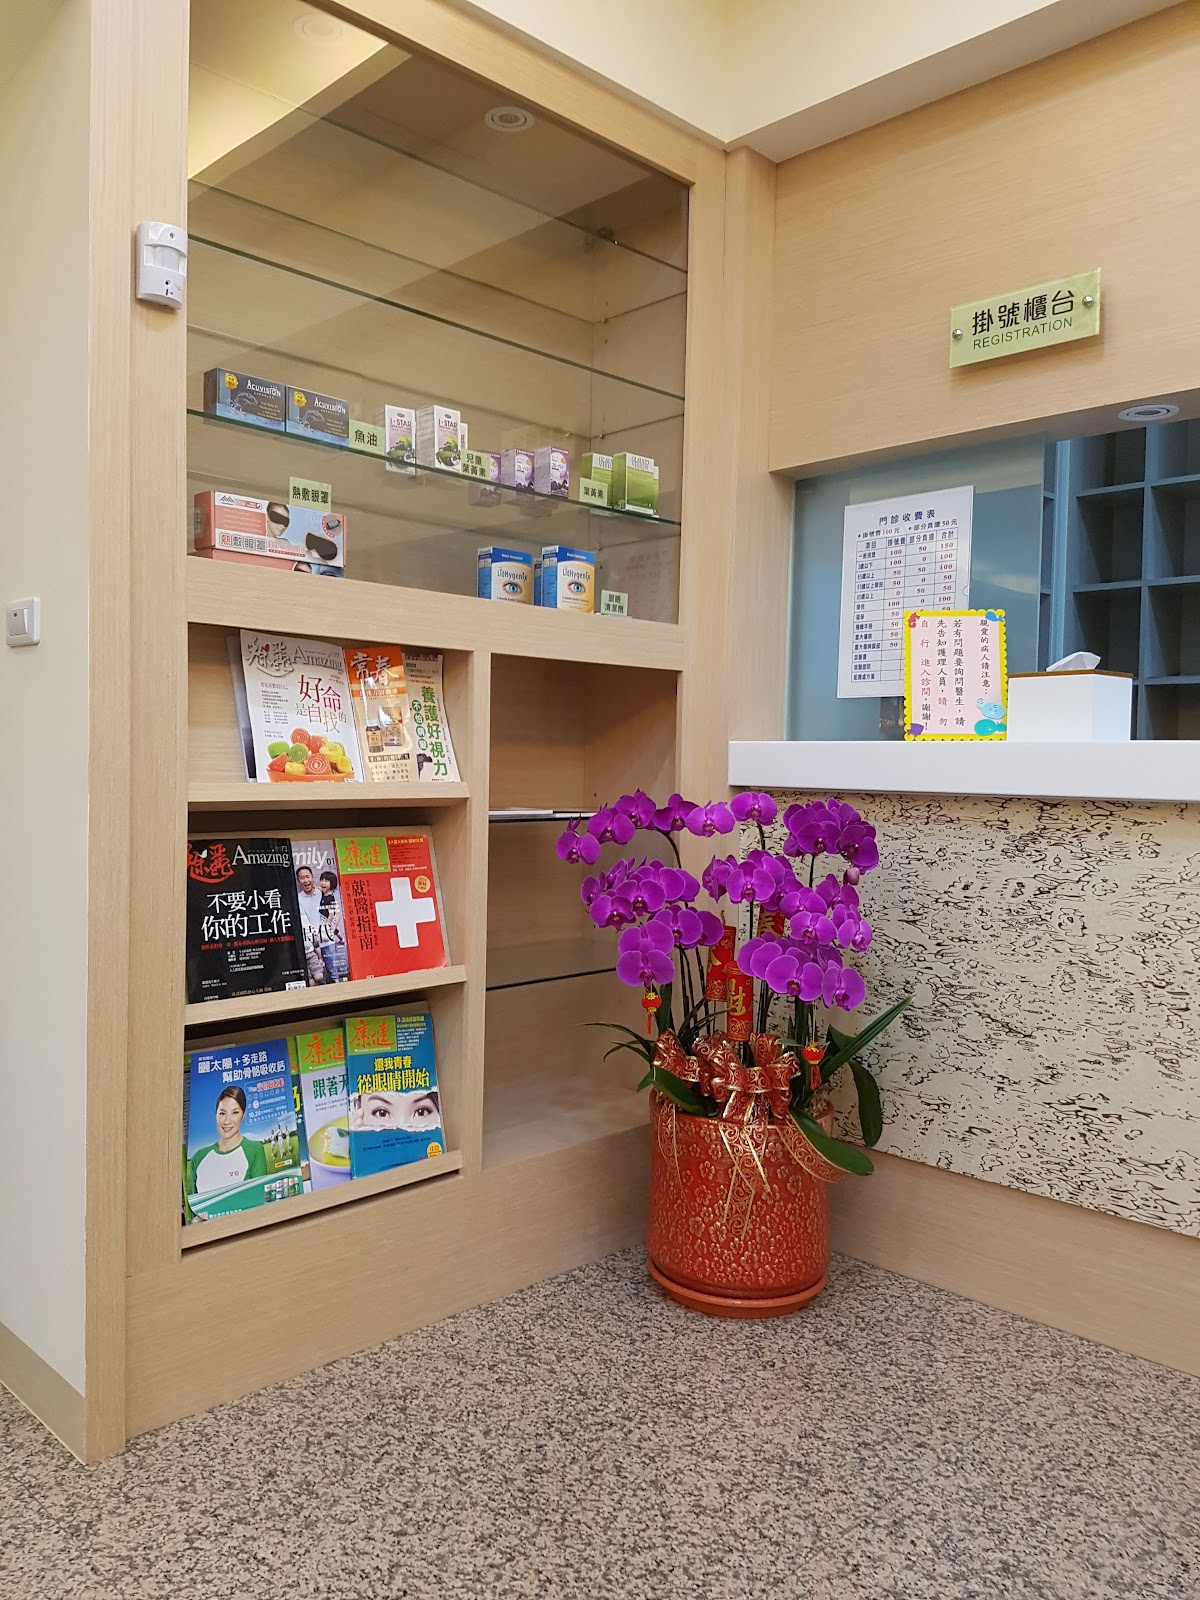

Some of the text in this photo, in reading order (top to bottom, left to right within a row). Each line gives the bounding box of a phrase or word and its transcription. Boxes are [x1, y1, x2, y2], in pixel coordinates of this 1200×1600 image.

[972, 290, 1074, 335] 掛號櫃台
[973, 317, 1073, 350] REGISTRATION
[354, 429, 378, 447] 魚油
[462, 464, 486, 477] 葉黃素
[466, 453, 482, 466] 兒童
[292, 486, 329, 504] 熱敷眼罩
[583, 486, 604, 499] 葉黃素
[879, 509, 936, 526] 門診收費表
[220, 533, 267, 552] 熱敷眼罩
[865, 541, 876, 549] 項目
[941, 530, 954, 540] 合計
[291, 645, 343, 674] Amazing
[350, 651, 400, 686] 常春
[297, 674, 341, 712] 好命
[295, 703, 347, 733] 是自找的
[421, 685, 448, 777] 養護好視力
[231, 844, 291, 868] Amazing
[341, 838, 389, 867] 康健
[206, 888, 281, 914] 不要小看
[201, 909, 292, 941] 你的工作
[351, 879, 374, 951] 就醫指南
[349, 1018, 395, 1048] 康健
[222, 1060, 286, 1084] 幫助骨骼吸收鈣
[374, 1055, 412, 1071] 還我青春
[357, 1067, 430, 1096] 從眼睛開始
